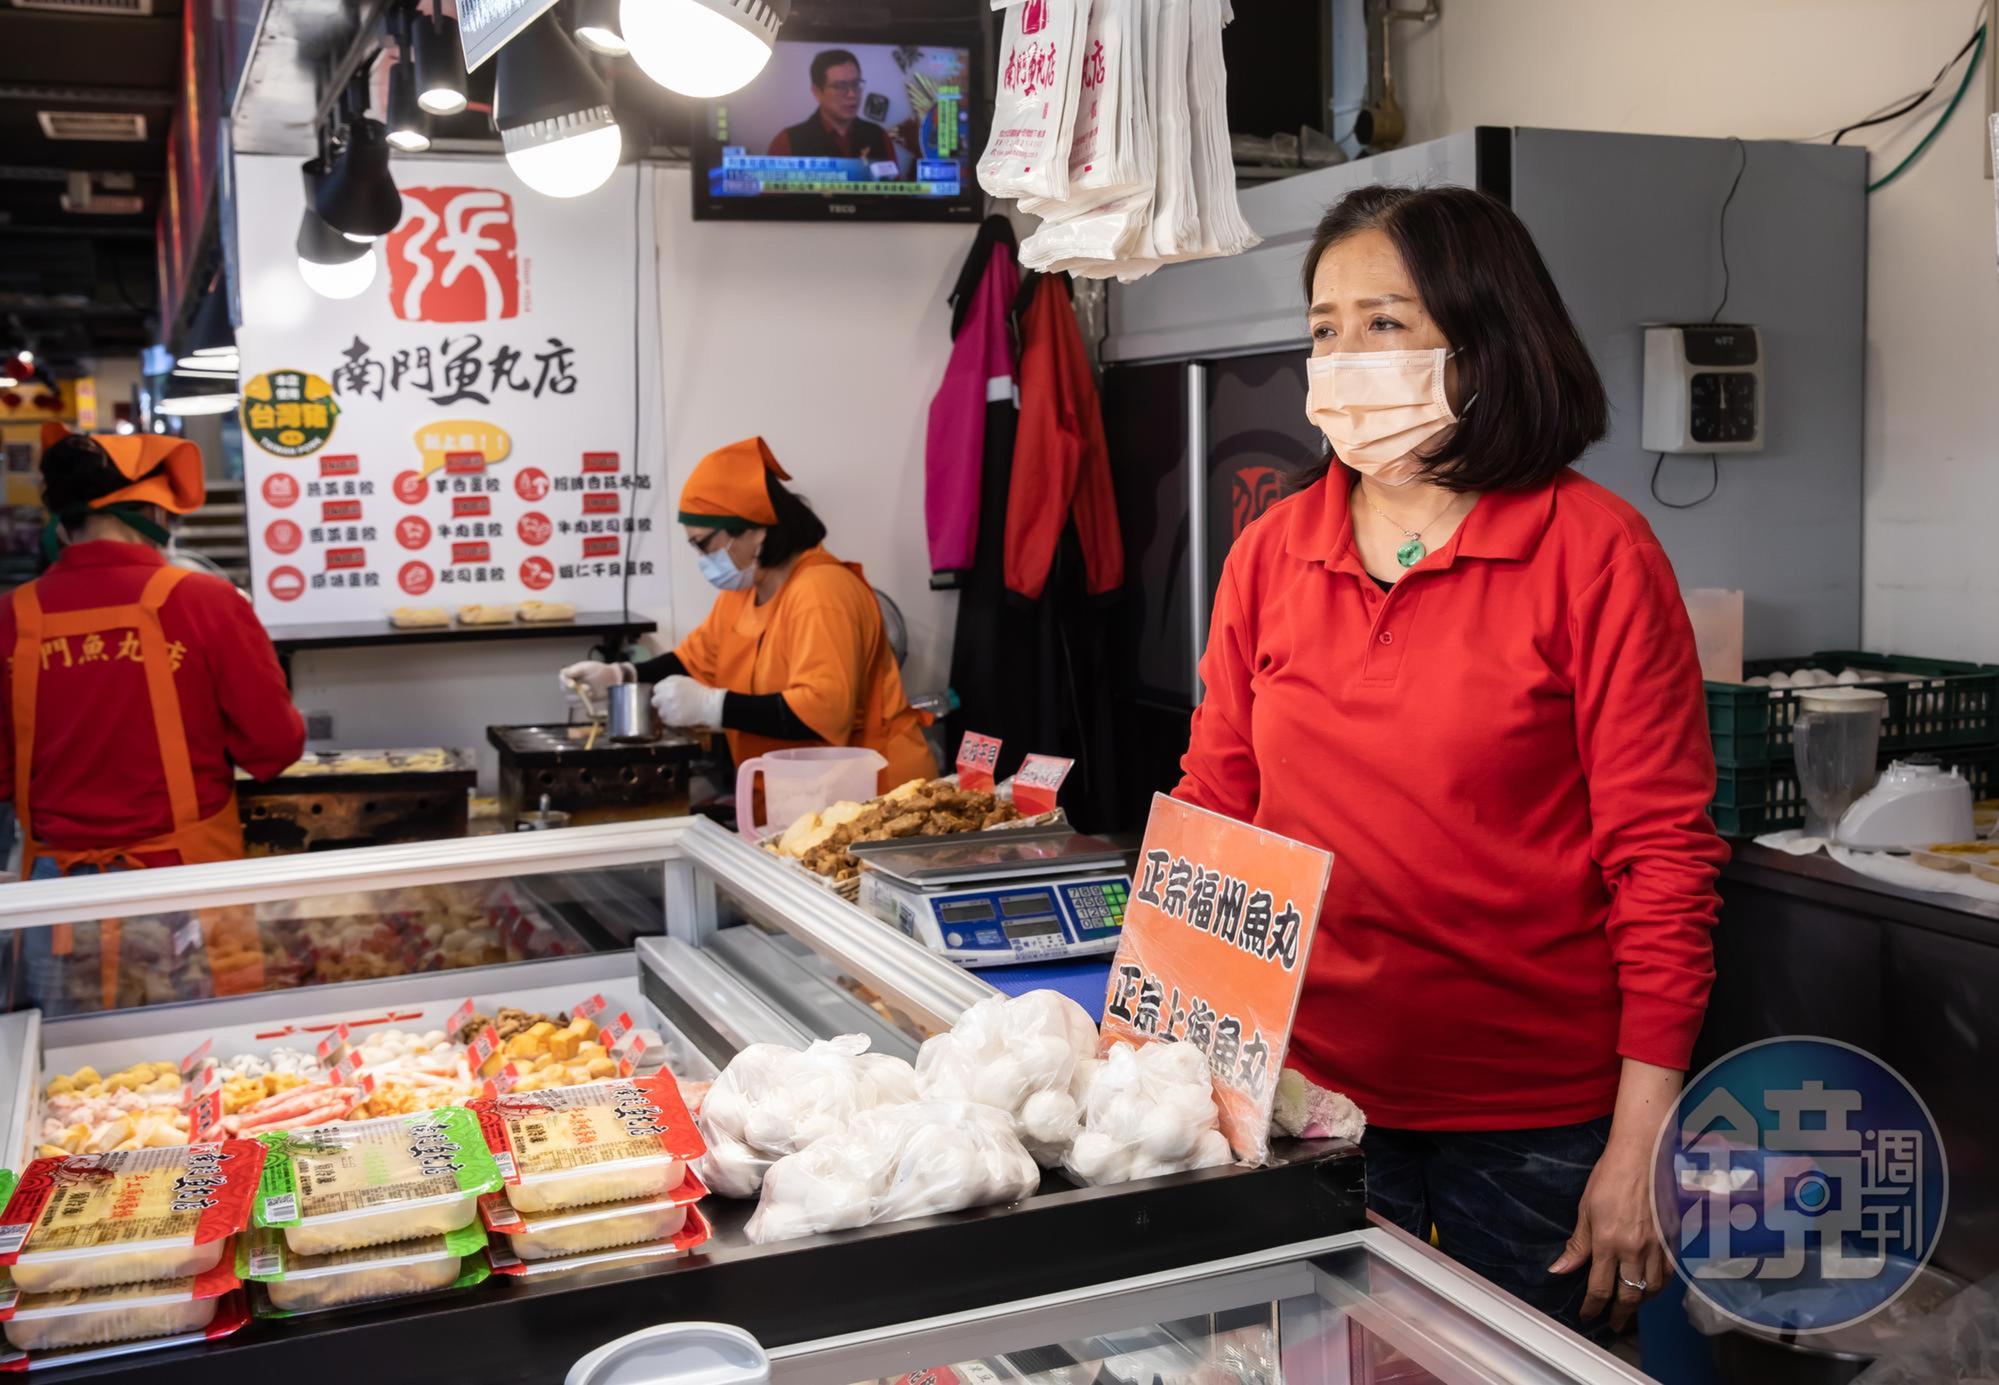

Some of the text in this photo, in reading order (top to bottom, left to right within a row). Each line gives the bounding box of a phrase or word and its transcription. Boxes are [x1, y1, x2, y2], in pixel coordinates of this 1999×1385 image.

[828, 204, 856, 215] TECO
[7, 631, 187, 677] 門魚丸店
[1137, 849, 1301, 972] 正宗福州魚丸
